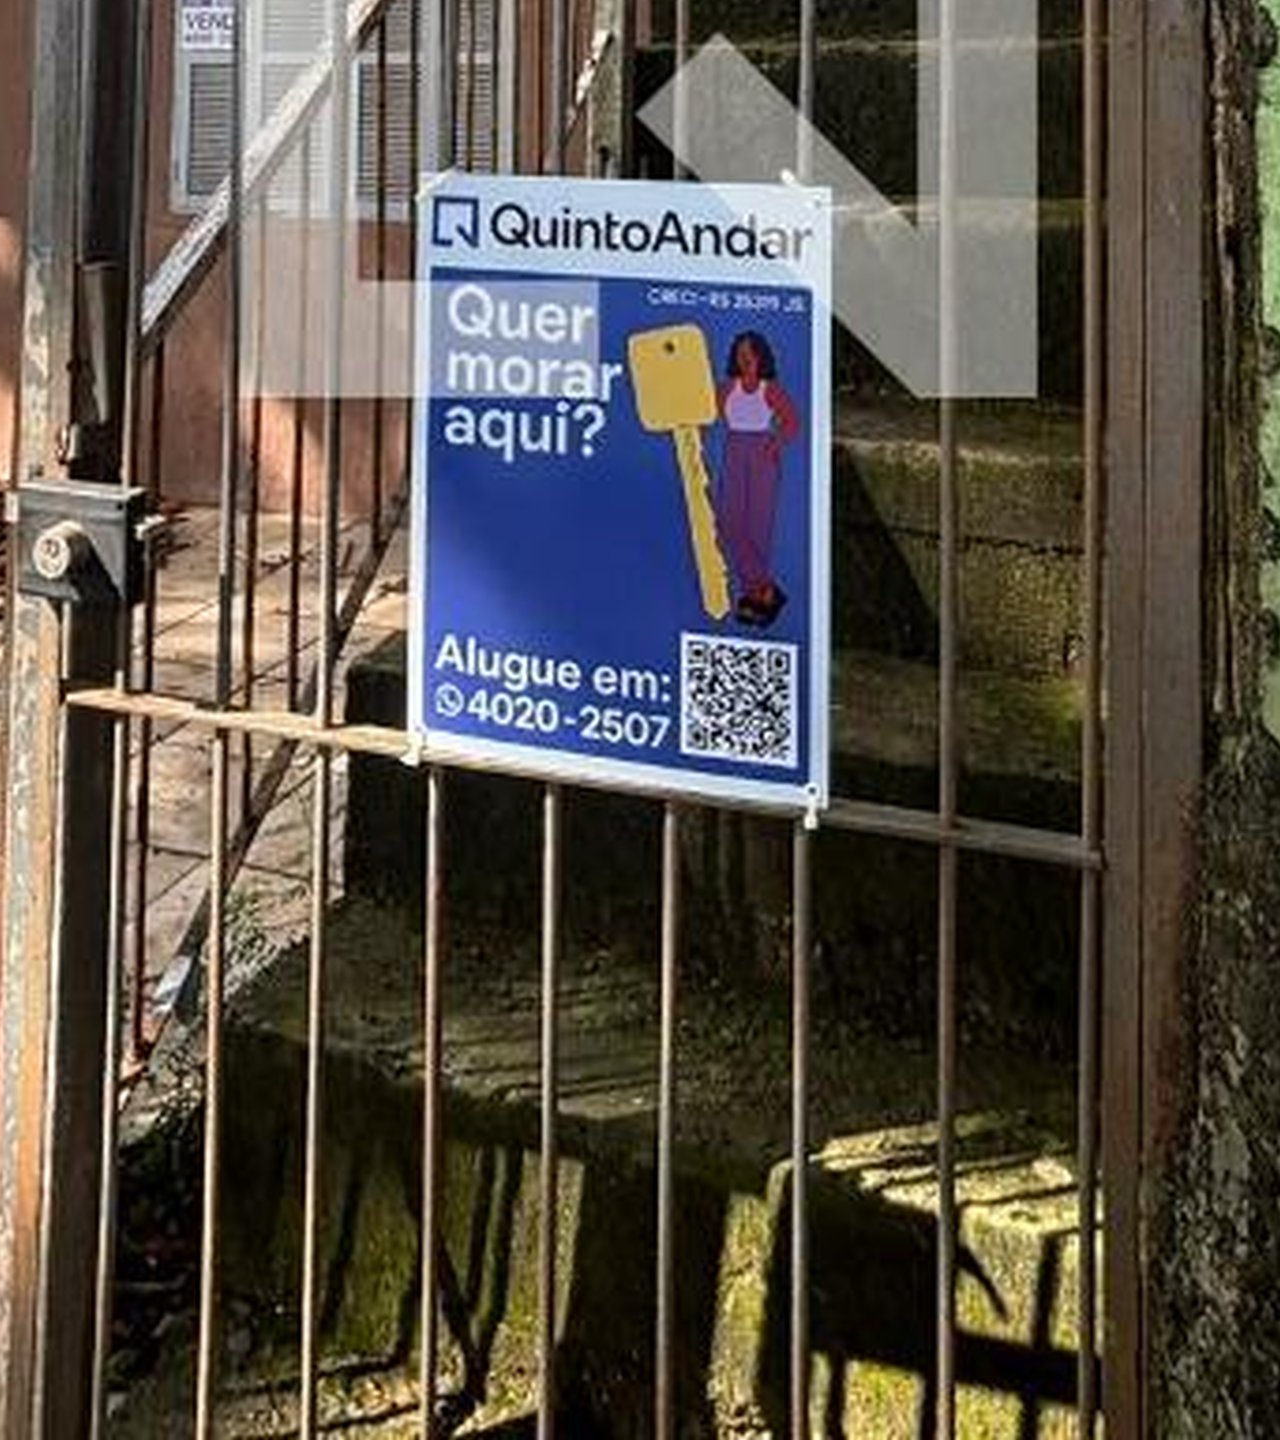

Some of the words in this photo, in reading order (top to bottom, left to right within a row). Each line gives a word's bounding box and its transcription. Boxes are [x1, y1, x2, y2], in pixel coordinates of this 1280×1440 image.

[490, 201, 813, 262] QuintoAndar
[447, 283, 597, 344] Quer
[446, 352, 623, 402] morar
[444, 402, 607, 464] aqui?
[434, 634, 582, 692] Alugue
[592, 666, 672, 704] em:
